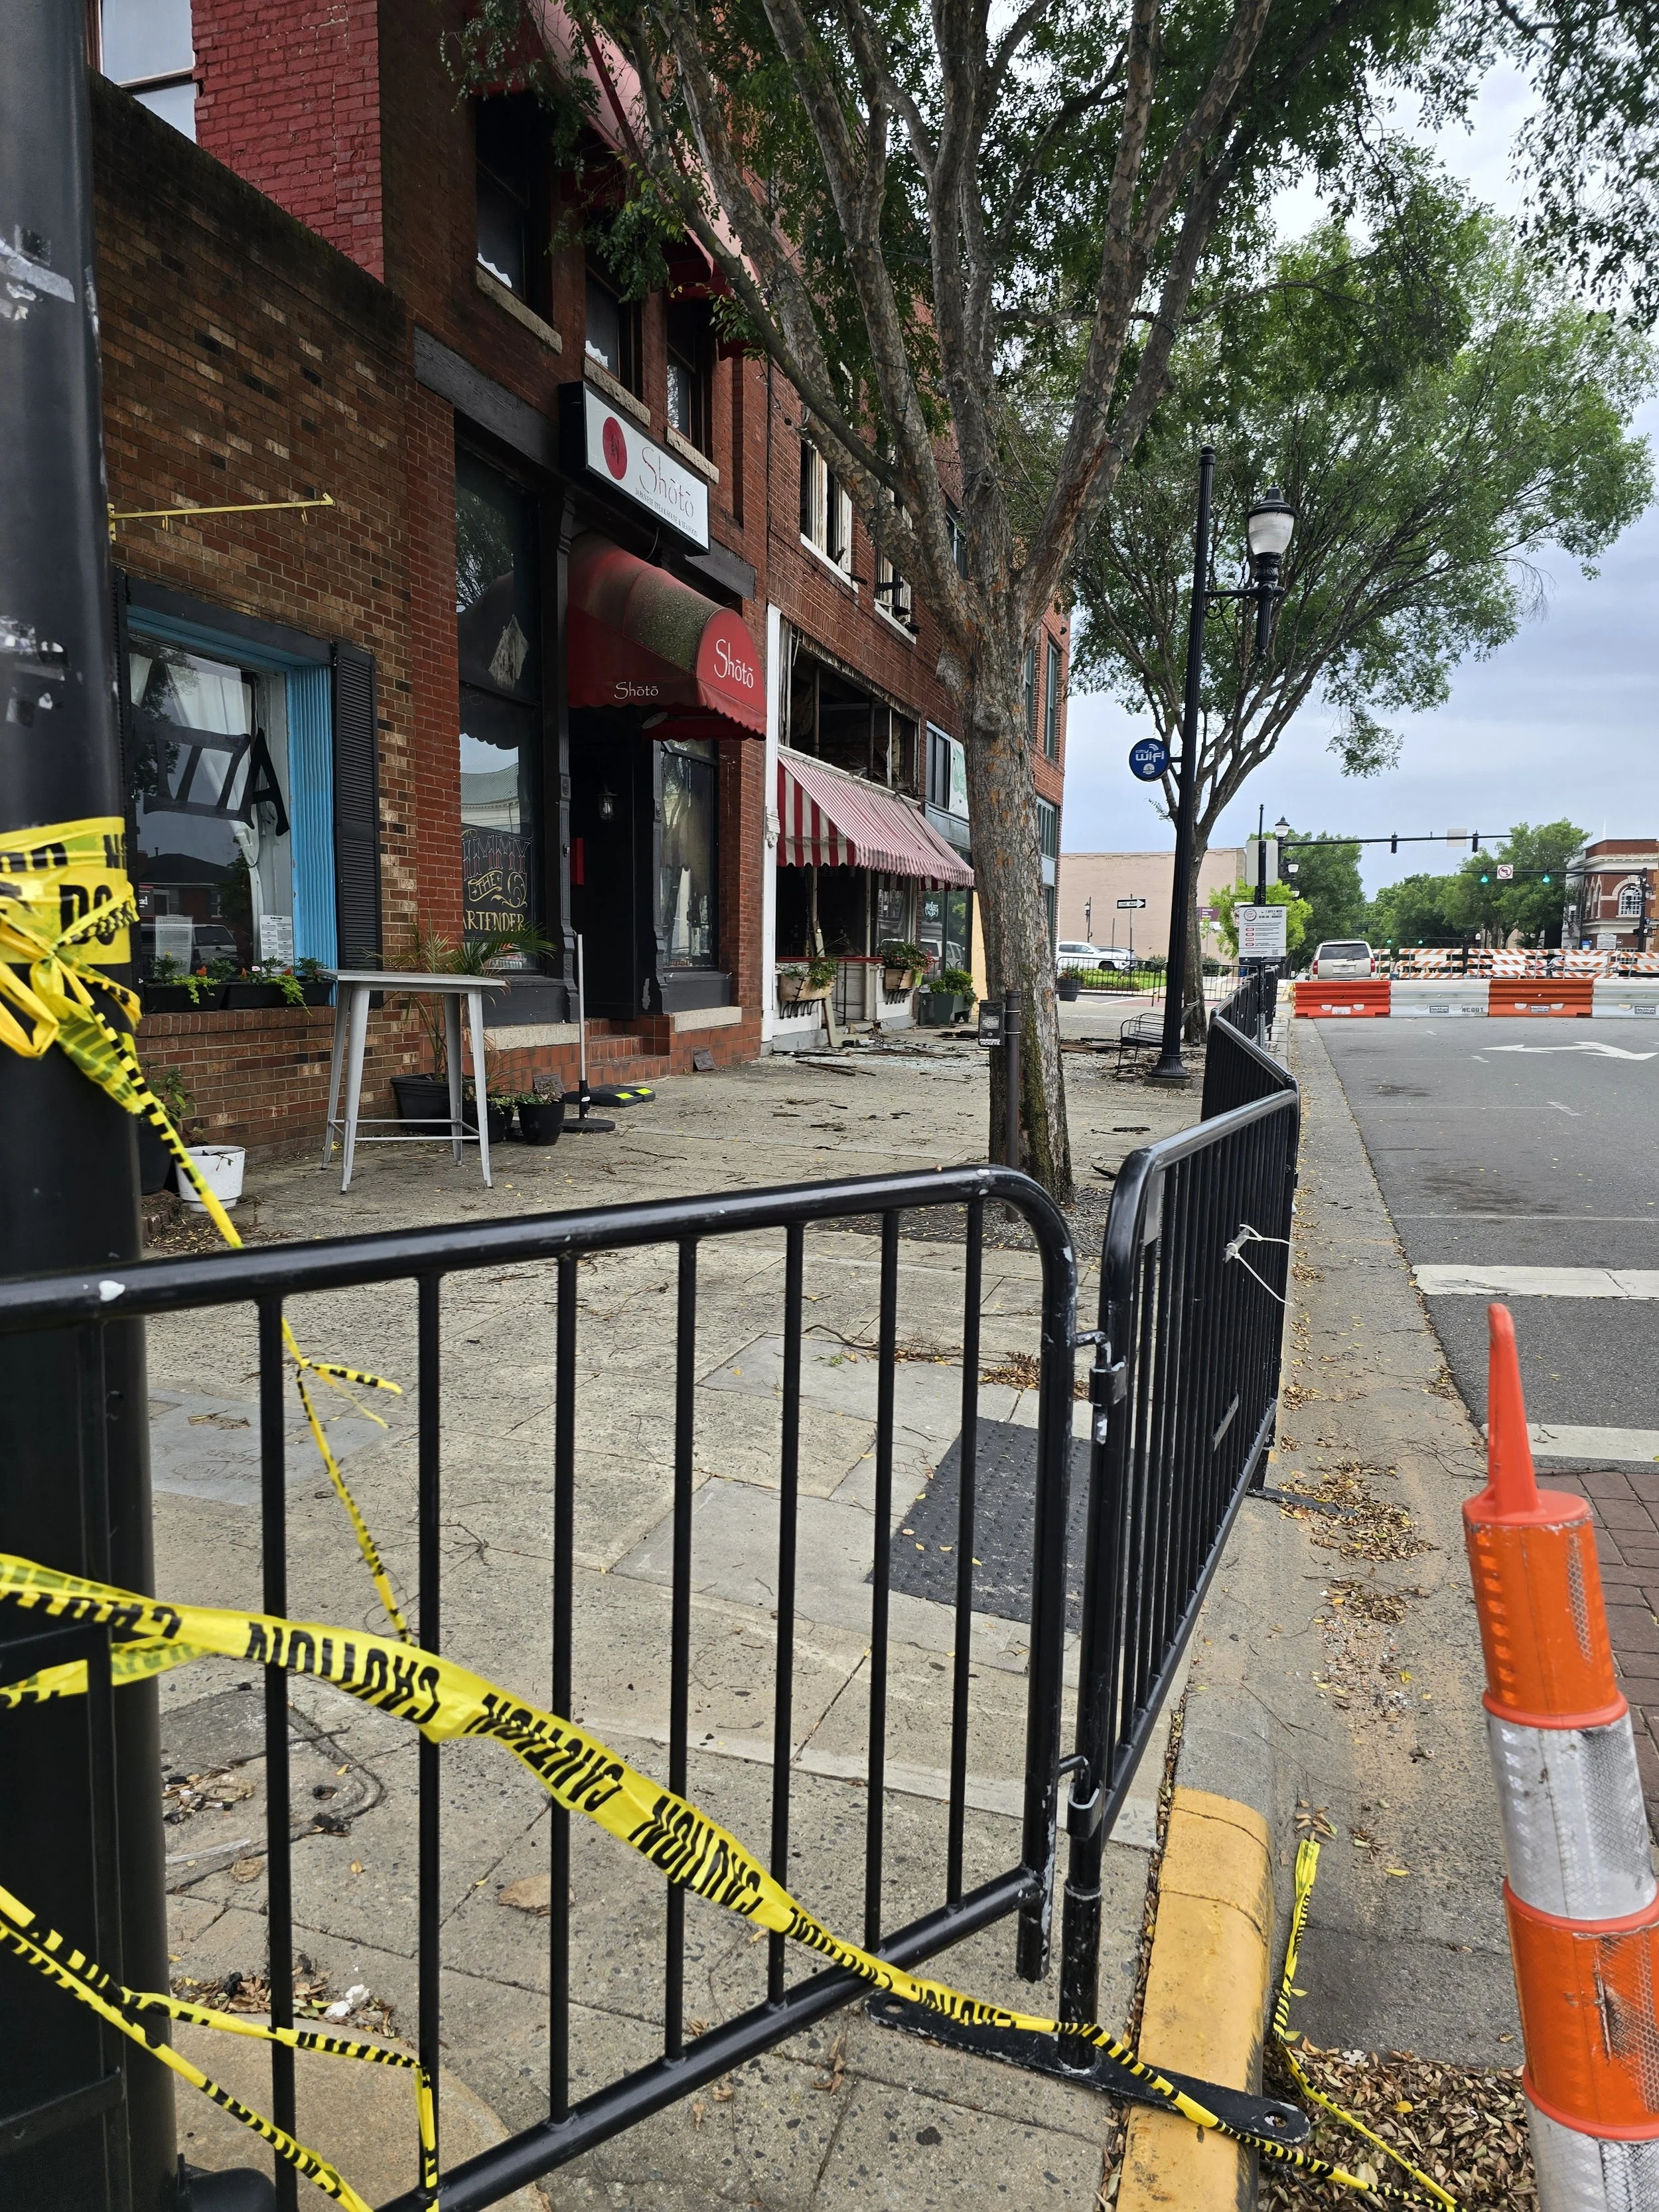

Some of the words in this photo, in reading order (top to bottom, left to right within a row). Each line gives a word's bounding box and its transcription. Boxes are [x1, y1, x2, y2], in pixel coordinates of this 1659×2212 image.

[462, 834, 531, 881] IMMY
[476, 873, 497, 895] THE
[464, 1692, 624, 1812] CAUTION
[627, 1795, 764, 1915] CAUTION
